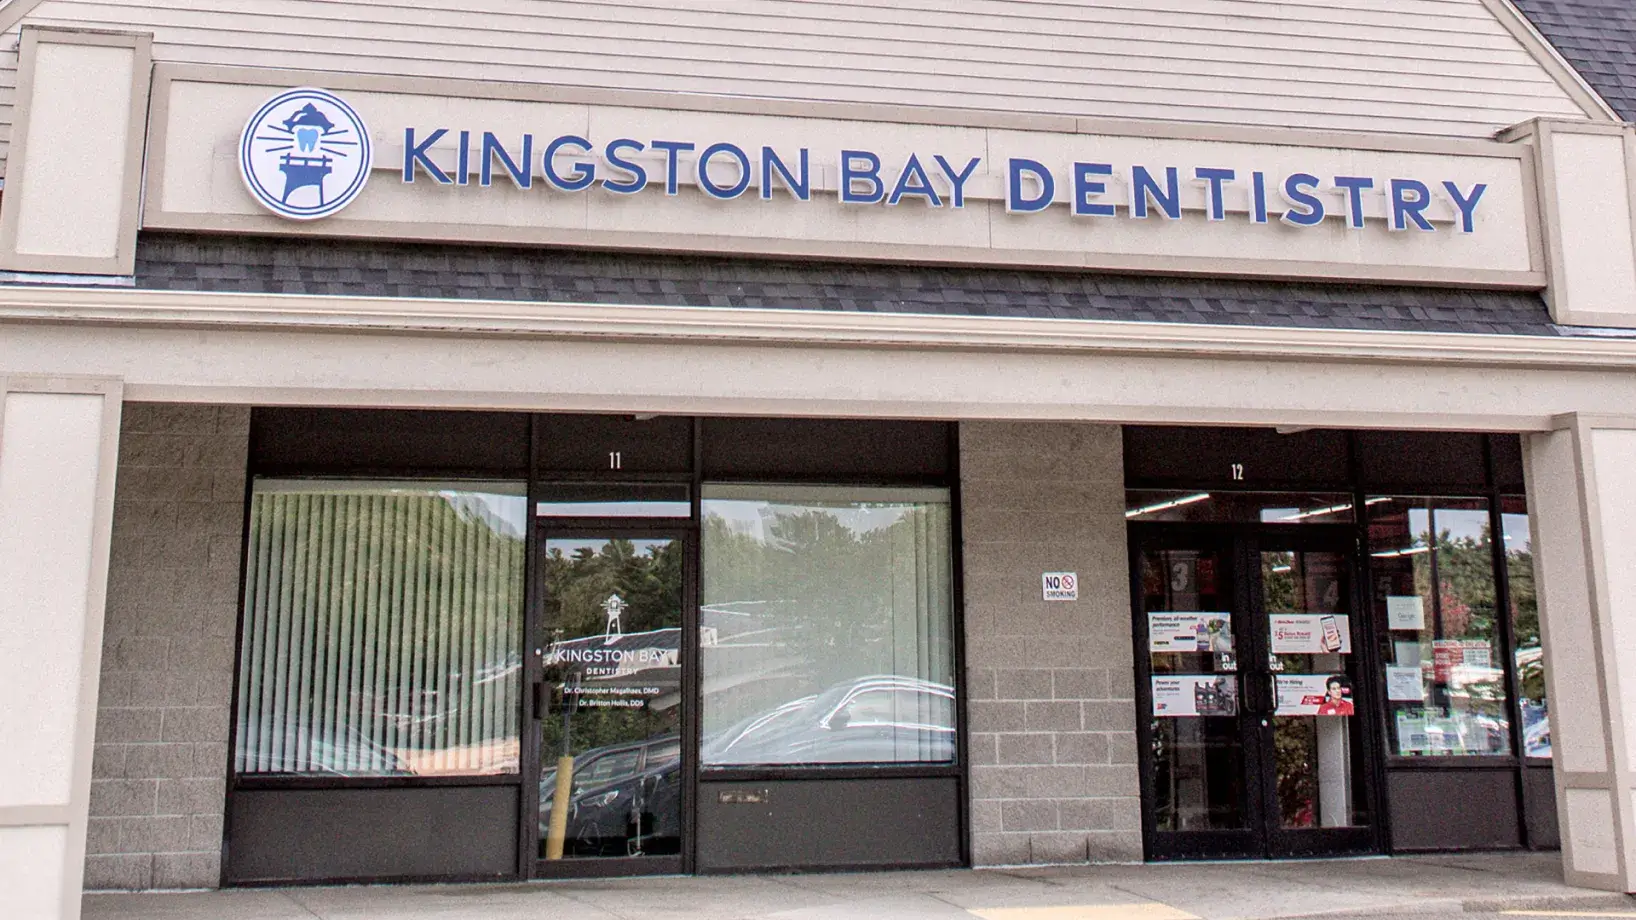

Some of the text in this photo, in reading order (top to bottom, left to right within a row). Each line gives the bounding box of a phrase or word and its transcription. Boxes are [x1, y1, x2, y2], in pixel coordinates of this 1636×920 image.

[403, 127, 1487, 234] KINGSTON BAY DENTISTRY
[609, 451, 621, 469] 11
[1231, 463, 1244, 480] 12
[1045, 576, 1060, 589] NO
[1171, 562, 1189, 592] 3
[555, 649, 668, 663] KINGSTON BAY
[586, 667, 639, 675] DENTISTRY
[1222, 661, 1238, 671] out
[1269, 661, 1285, 671] out
[574, 687, 609, 695] Christopher
